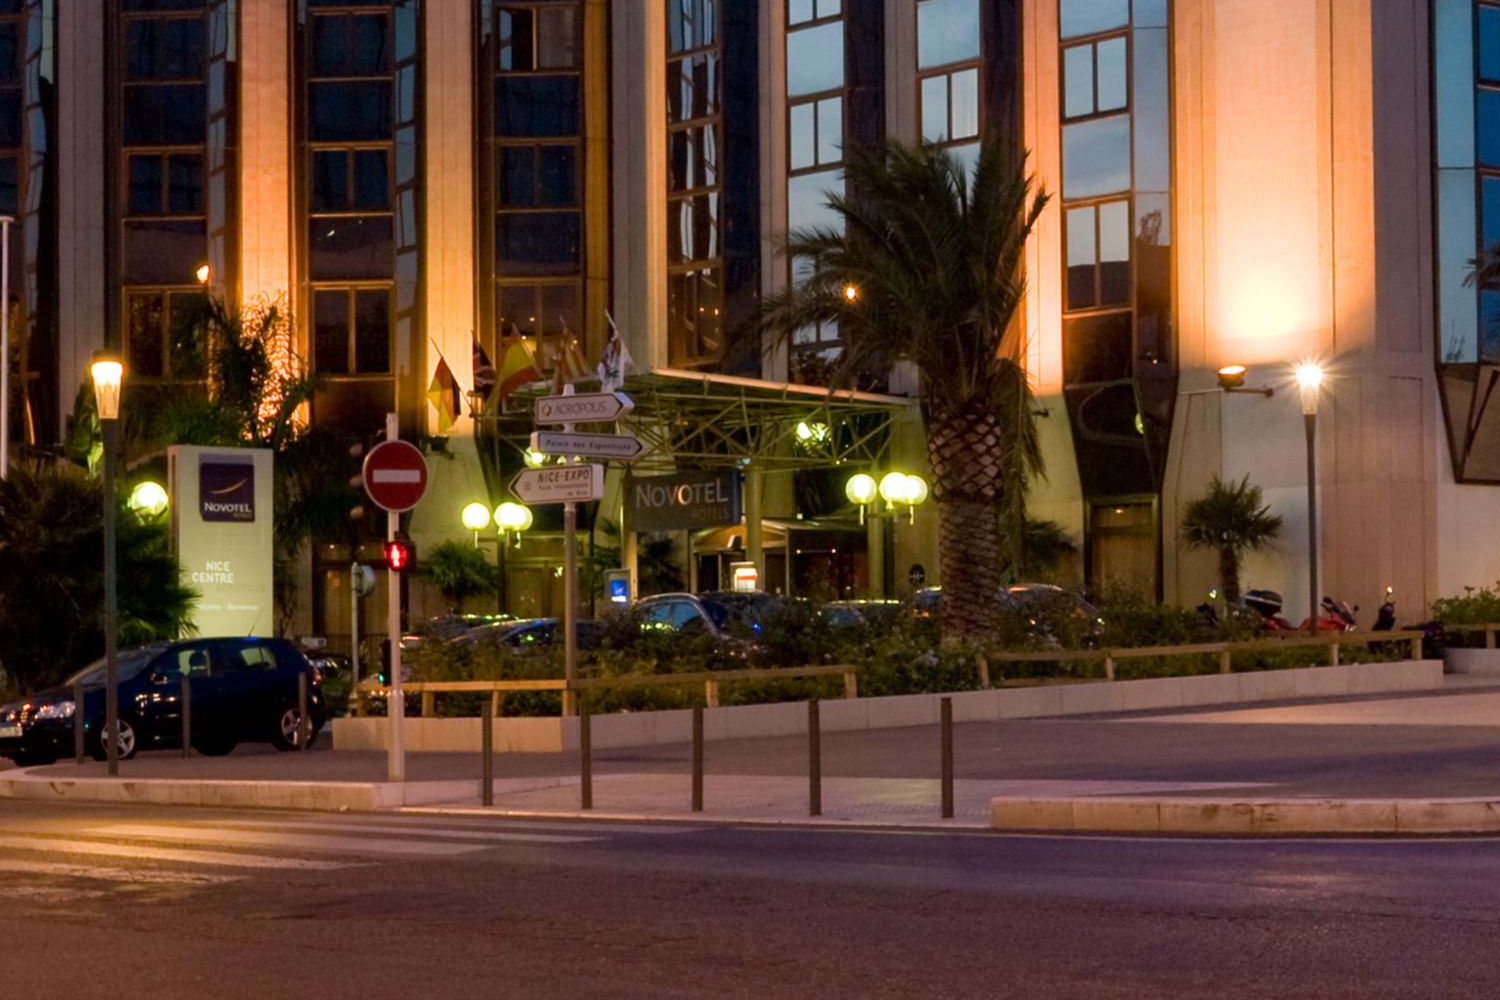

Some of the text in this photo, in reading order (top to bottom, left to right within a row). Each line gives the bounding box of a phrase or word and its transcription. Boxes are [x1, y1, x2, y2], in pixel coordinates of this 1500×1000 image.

[555, 401, 607, 415] ACROPOLIS
[636, 479, 729, 509] NOVOTEL
[204, 502, 252, 513] NOVOTEL
[205, 560, 231, 572] NICE
[192, 572, 235, 584] CENTRE
